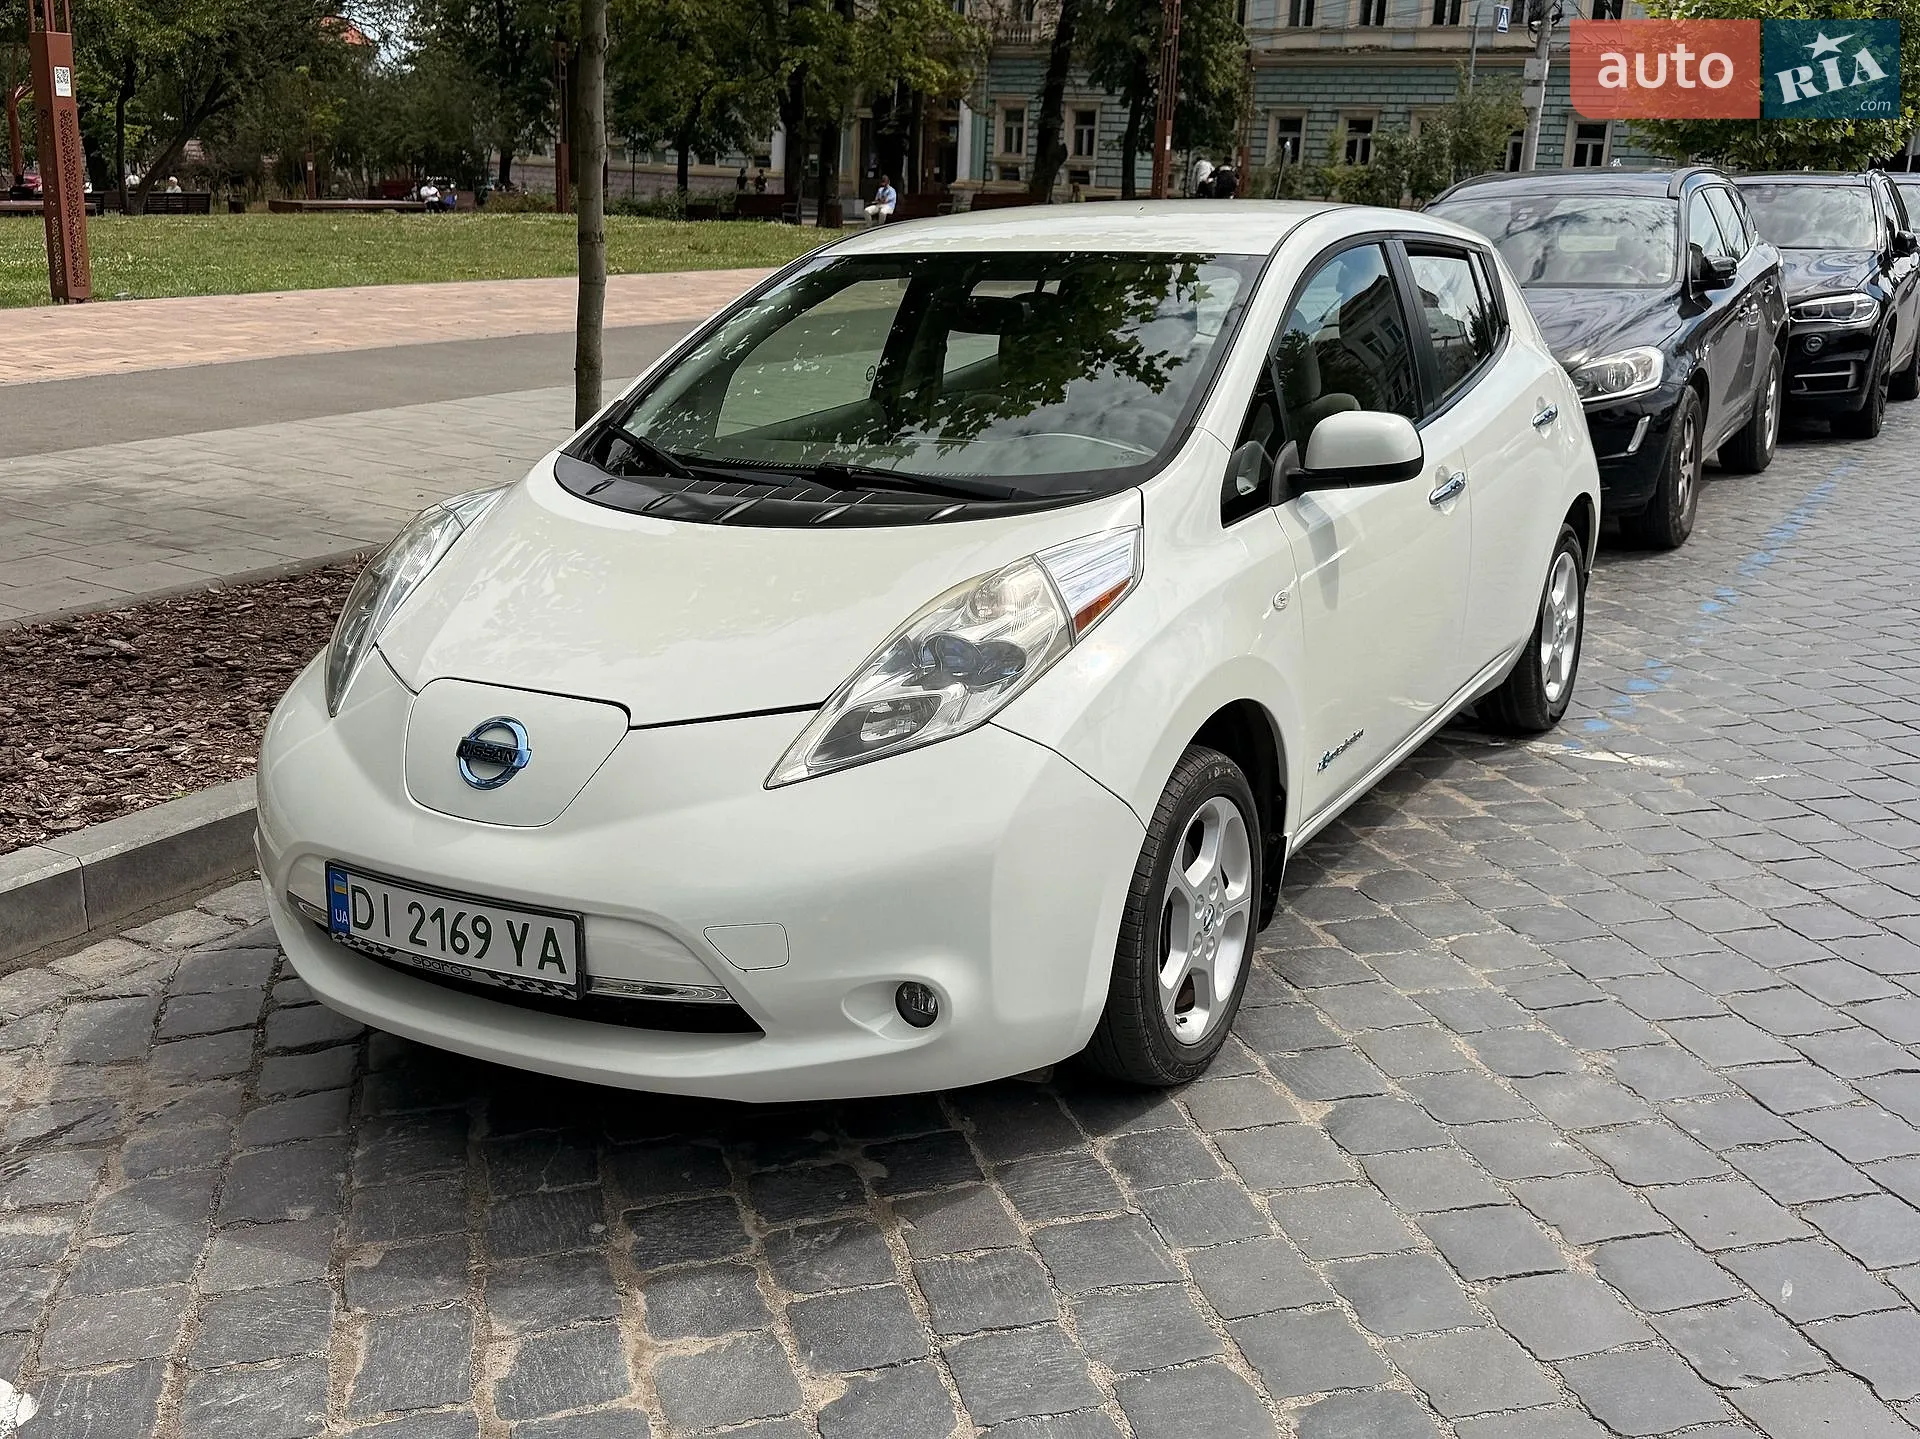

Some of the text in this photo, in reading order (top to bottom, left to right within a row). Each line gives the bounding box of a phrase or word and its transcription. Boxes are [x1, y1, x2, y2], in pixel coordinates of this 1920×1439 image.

[335, 908, 348, 925] UA
[350, 884, 567, 974] DI 2169 YA
[412, 956, 472, 977] sparco
